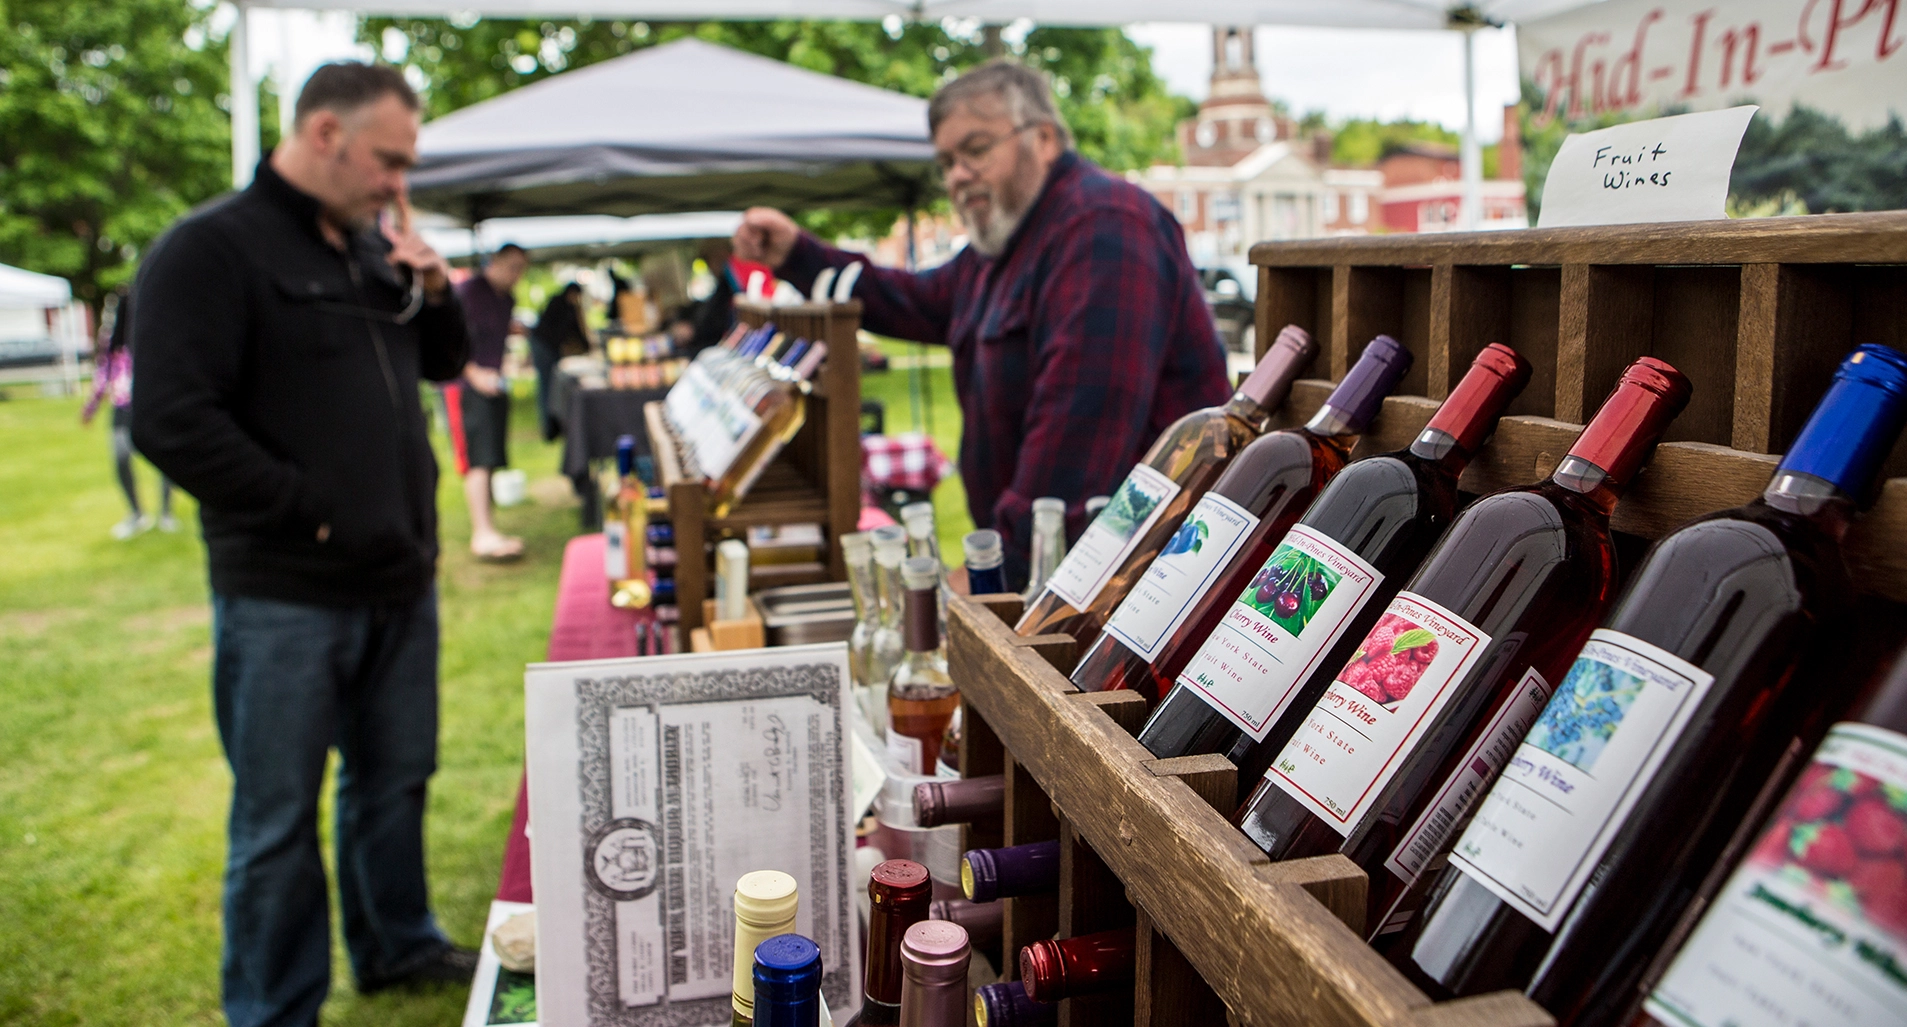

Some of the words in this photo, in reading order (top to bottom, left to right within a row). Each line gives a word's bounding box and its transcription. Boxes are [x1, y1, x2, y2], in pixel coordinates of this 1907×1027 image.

[1593, 142, 1667, 169] Fruit
[1603, 171, 1672, 190] Wines
[1213, 505, 1243, 527] Vineyard
[1326, 554, 1367, 584] Vineyard
[1142, 589, 1160, 605] State
[1229, 608, 1253, 628] Cherry
[1252, 620, 1279, 645] Wine
[1423, 613, 1471, 646] Vineyard
[1220, 636, 1241, 655] York
[1241, 651, 1269, 675] State
[1219, 661, 1243, 683] Wine
[1623, 656, 1686, 692] Vineyard
[1241, 710, 1253, 722] 750
[1251, 719, 1262, 728] ml
[1346, 699, 1378, 726] Wine
[1306, 717, 1325, 734] York
[1326, 730, 1355, 755] State
[1302, 743, 1327, 766] Wine
[1537, 764, 1576, 795] Wine
[1323, 796, 1337, 810] 750
[1335, 806, 1347, 818] ml
[1512, 800, 1537, 821] State
